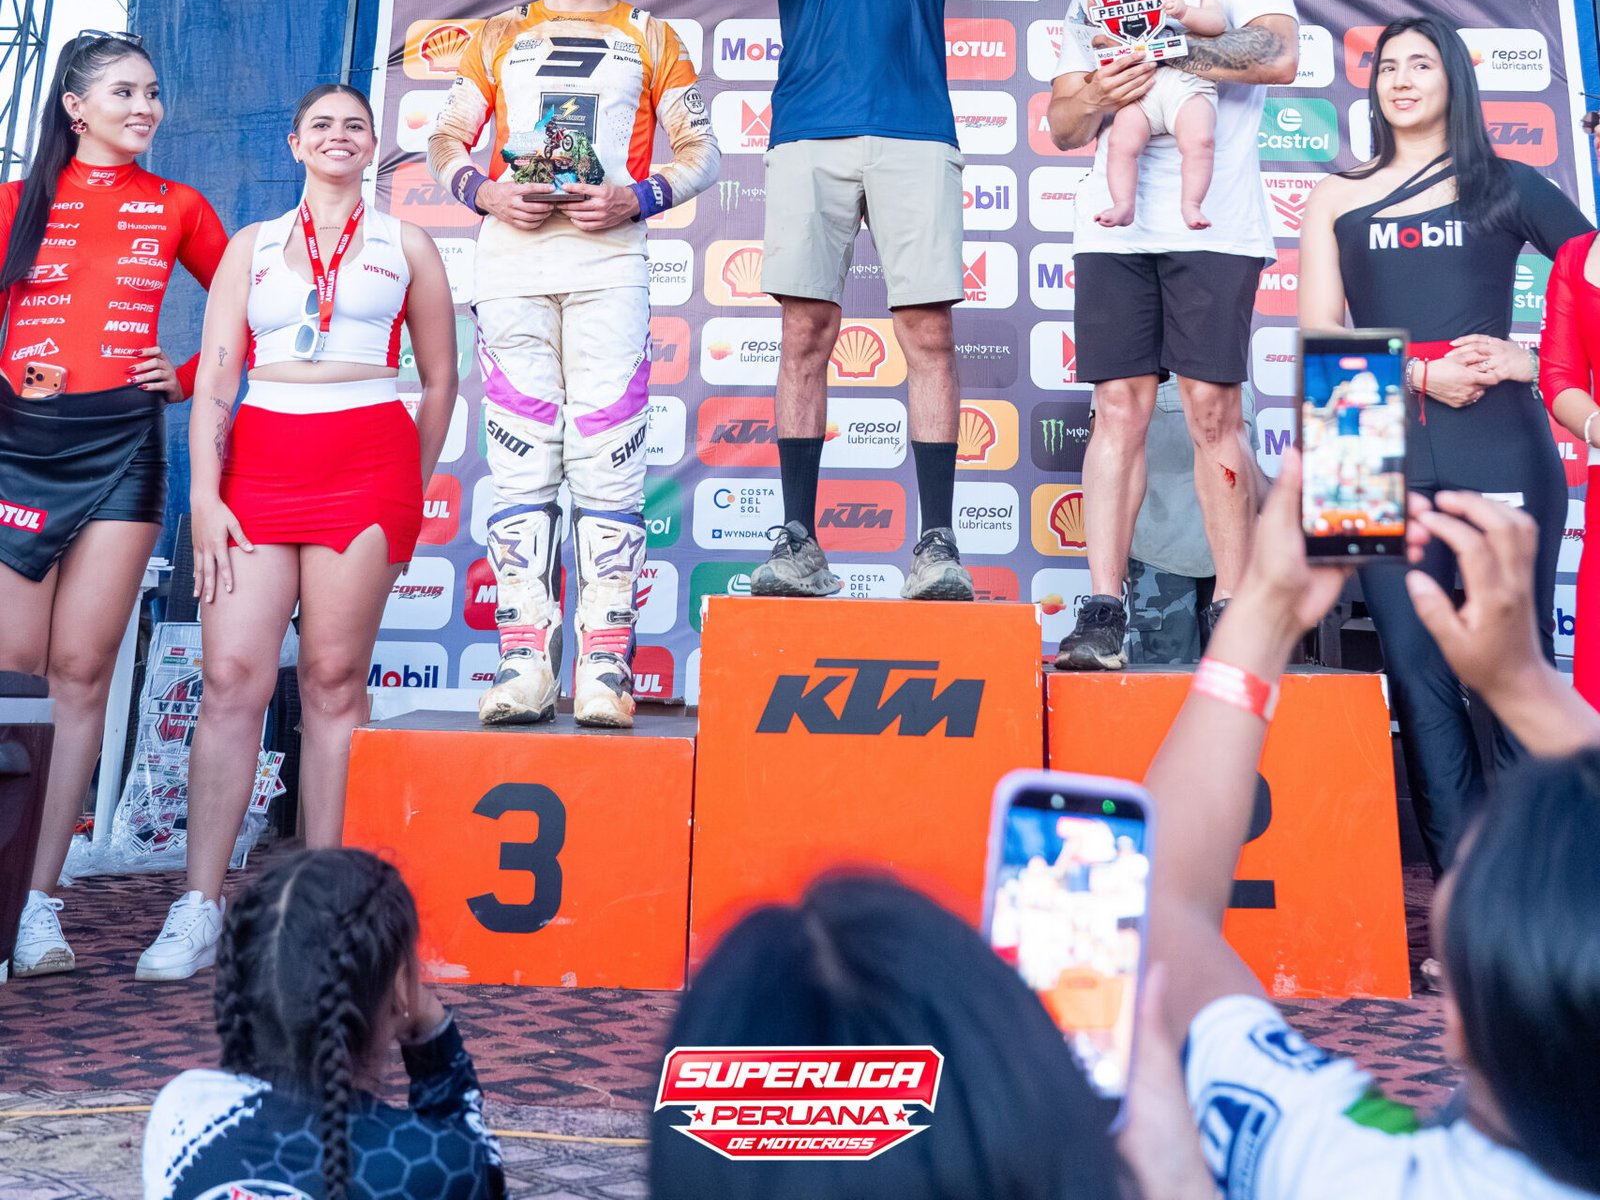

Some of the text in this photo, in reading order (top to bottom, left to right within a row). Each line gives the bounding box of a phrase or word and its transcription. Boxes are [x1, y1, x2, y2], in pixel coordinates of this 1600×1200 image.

[1099, 0, 1162, 19] PERUANA
[721, 37, 784, 61] Mob
[1491, 48, 1543, 62] repsol
[1491, 60, 1544, 71] lubricants
[955, 115, 1008, 124] COPUR
[1257, 132, 1330, 150] Castrol
[119, 201, 165, 214] KTM
[127, 223, 167, 231] Husqvarna
[1369, 220, 1463, 249] Mobil
[118, 256, 168, 269] GASGAS
[648, 260, 688, 275] epsol
[363, 264, 400, 283] VISTONY
[115, 276, 165, 290] TRIUMPH
[20, 294, 72, 307] AIROH
[965, 291, 987, 301] MC
[108, 301, 154, 313] POLARIS
[16, 317, 66, 327] ACERBIS
[104, 320, 150, 334] MOTUL
[954, 343, 1011, 355] MONSTER
[649, 405, 668, 413] STA
[848, 420, 901, 436] repsol
[487, 419, 534, 457] SHOT
[847, 434, 900, 445] lubricants
[740, 488, 775, 496] COSTA
[740, 497, 761, 505] DEL
[0, 503, 40, 530] TUL
[740, 506, 760, 514] SOL
[817, 503, 893, 529] KTM
[959, 505, 1013, 520] repsol
[958, 519, 1012, 531] lubricants
[724, 530, 771, 539] WYNDHAM
[850, 574, 885, 582] COSTA
[390, 585, 444, 594] COPUR
[850, 583, 871, 591] DEL
[755, 658, 986, 738] KTM
[466, 782, 567, 934] 3
